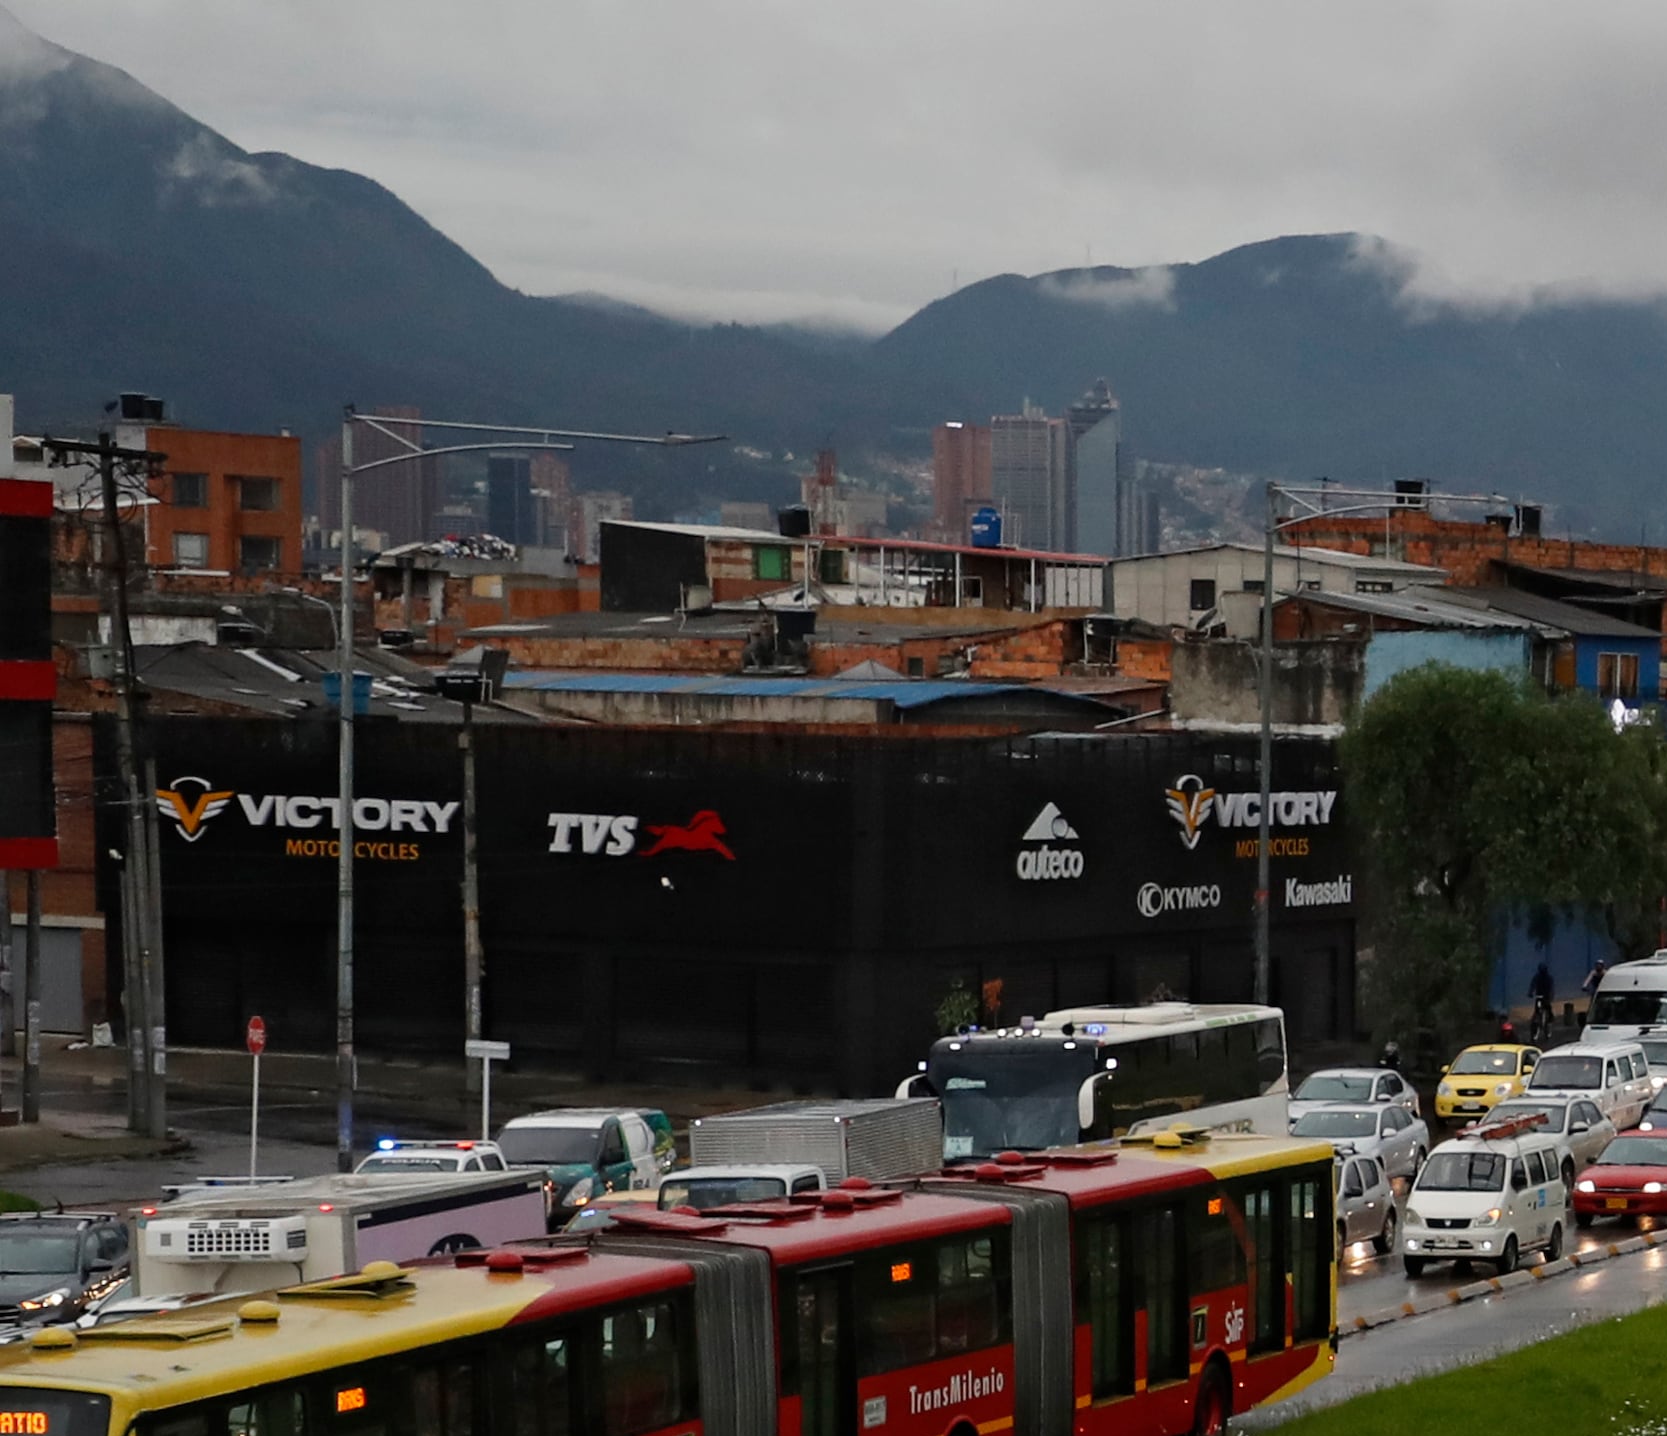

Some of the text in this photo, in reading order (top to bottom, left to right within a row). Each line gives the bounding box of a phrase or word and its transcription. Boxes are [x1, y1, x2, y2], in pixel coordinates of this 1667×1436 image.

[237, 794, 459, 833] VICTORY
[1214, 792, 1337, 828] VICTORY
[286, 839, 419, 860] MOTOCYCLES
[547, 813, 638, 856] TVS
[1235, 838, 1309, 858] MOTRCYCLES
[1017, 845, 1084, 880] auteco
[1164, 885, 1220, 911] KYMCO
[1285, 875, 1352, 907] Kawasaki
[909, 1367, 1004, 1415] TransMilenio
